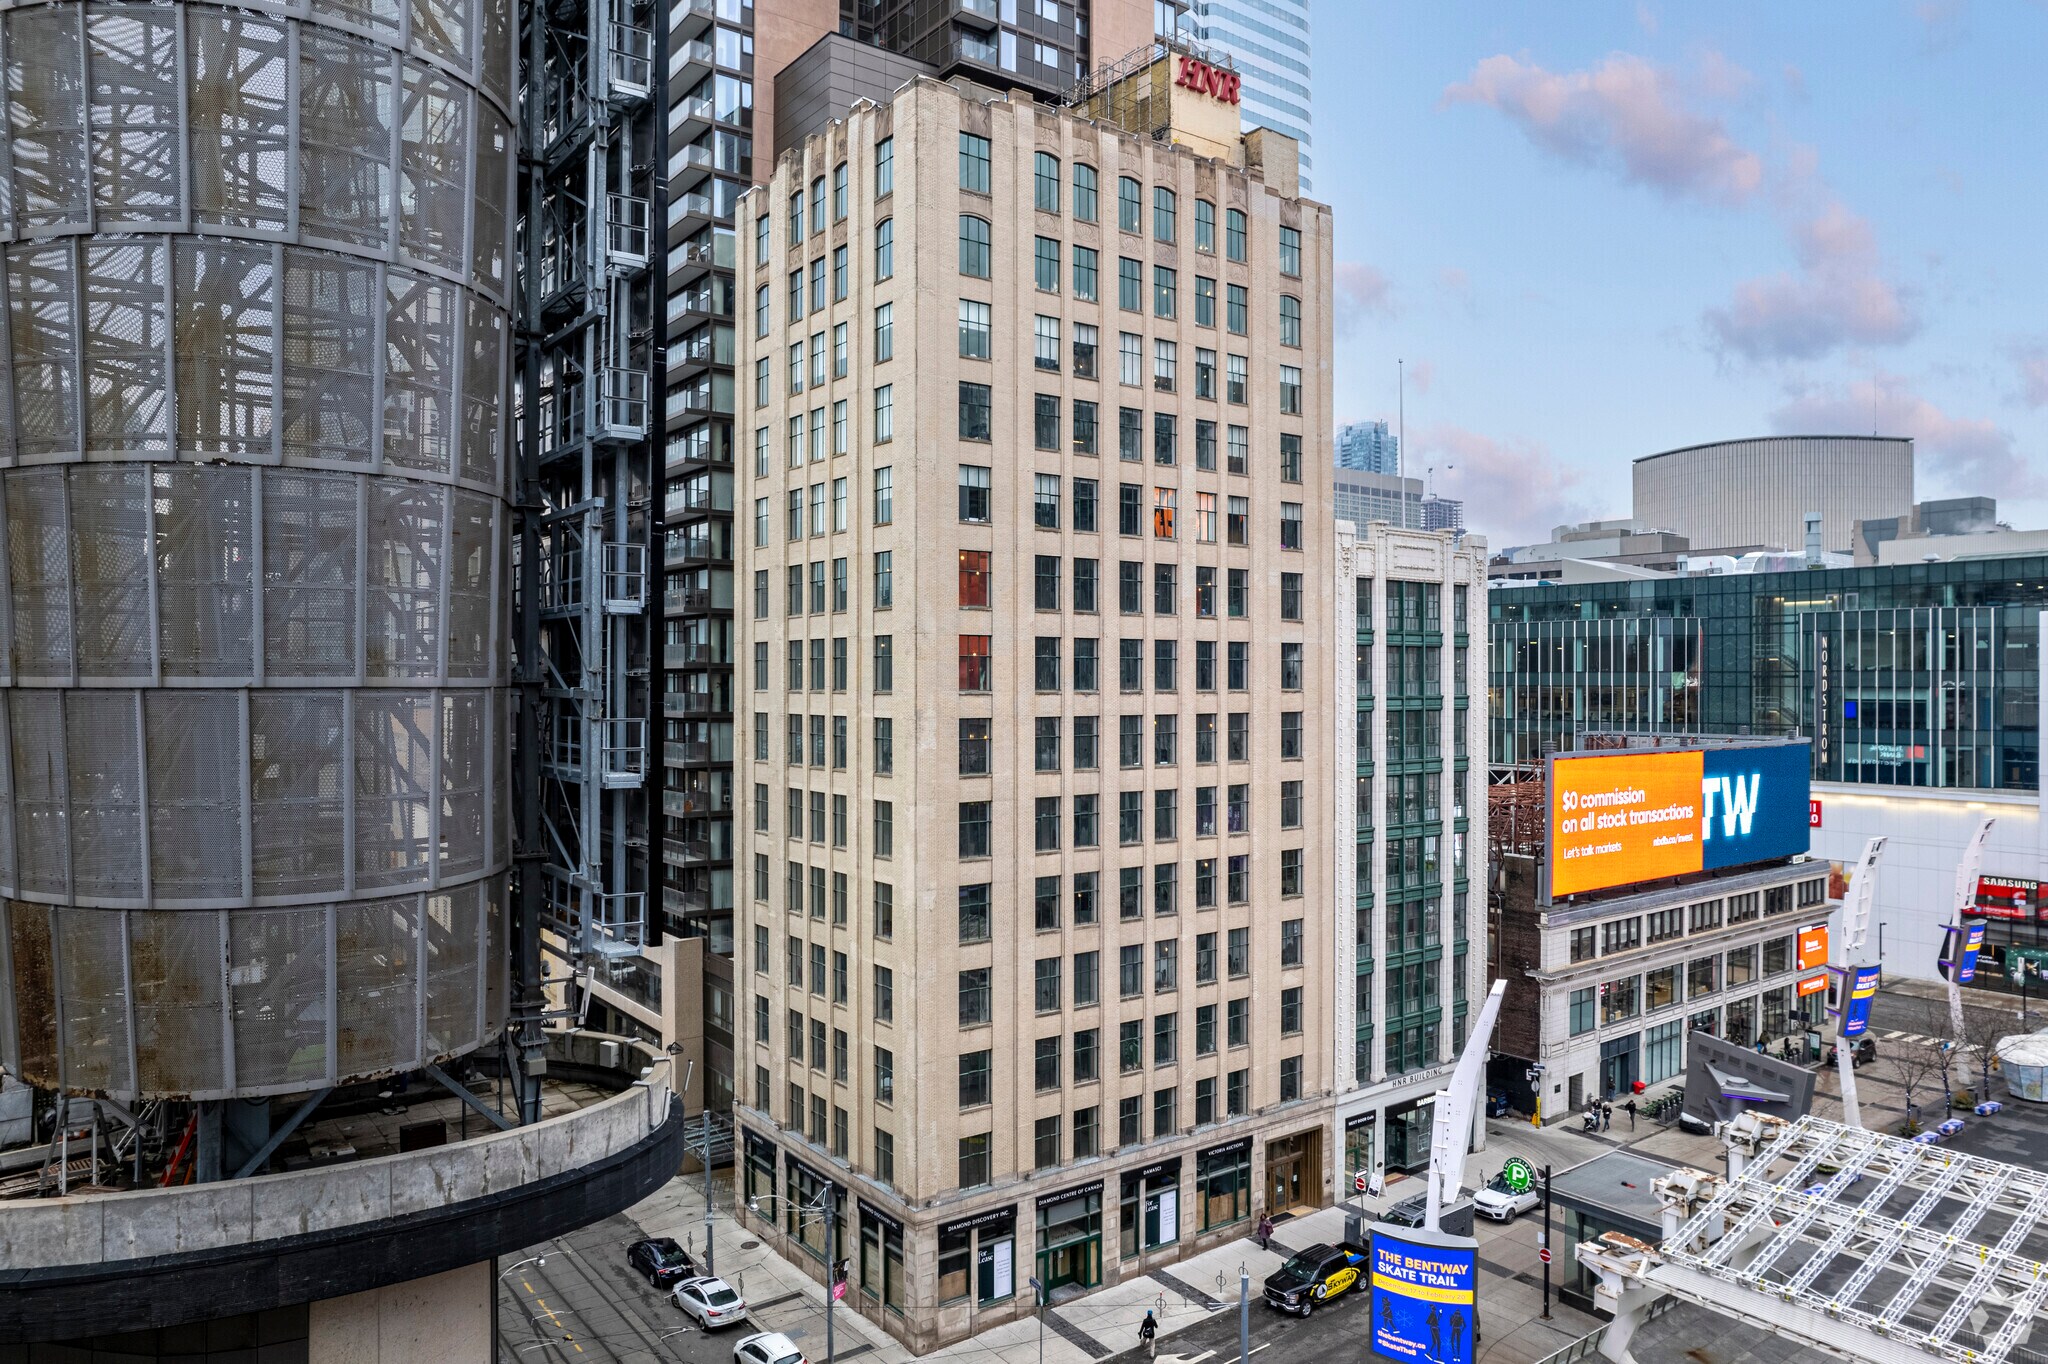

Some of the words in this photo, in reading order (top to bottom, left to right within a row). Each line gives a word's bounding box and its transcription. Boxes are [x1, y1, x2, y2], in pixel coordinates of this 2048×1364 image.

[1175, 55, 1240, 105] HNR
[1562, 790, 1578, 812] $0
[1580, 786, 1646, 808] commission
[1562, 818, 1578, 833] on
[1580, 812, 1594, 831] all
[1597, 809, 1628, 830] stock
[1630, 803, 1694, 825] transactions
[1564, 847, 1580, 859] Let's
[1581, 844, 1594, 857] talk
[1596, 842, 1622, 854] markets
[1983, 877, 2037, 890] SAMSUNG
[1392, 1078, 1406, 1087] HNR
[1410, 1067, 1442, 1083] BUILDING
[1512, 1166, 1525, 1180] P
[1038, 1196, 1060, 1206] DIAMOND
[1060, 1190, 1077, 1199] CENTRE
[1084, 1183, 1102, 1192] CANADA
[860, 1201, 873, 1214] DIAMOND
[948, 1221, 971, 1232] DIAMOND
[972, 1213, 999, 1225] DISCOVERY
[979, 1255, 993, 1264] Lease
[1378, 1248, 1402, 1266] THE
[1405, 1257, 1468, 1275] BENTWAY
[1378, 1261, 1416, 1281] SKATE
[1419, 1272, 1458, 1287] TRAIL
[1378, 1278, 1408, 1292] December
[1427, 1291, 1455, 1300] February
